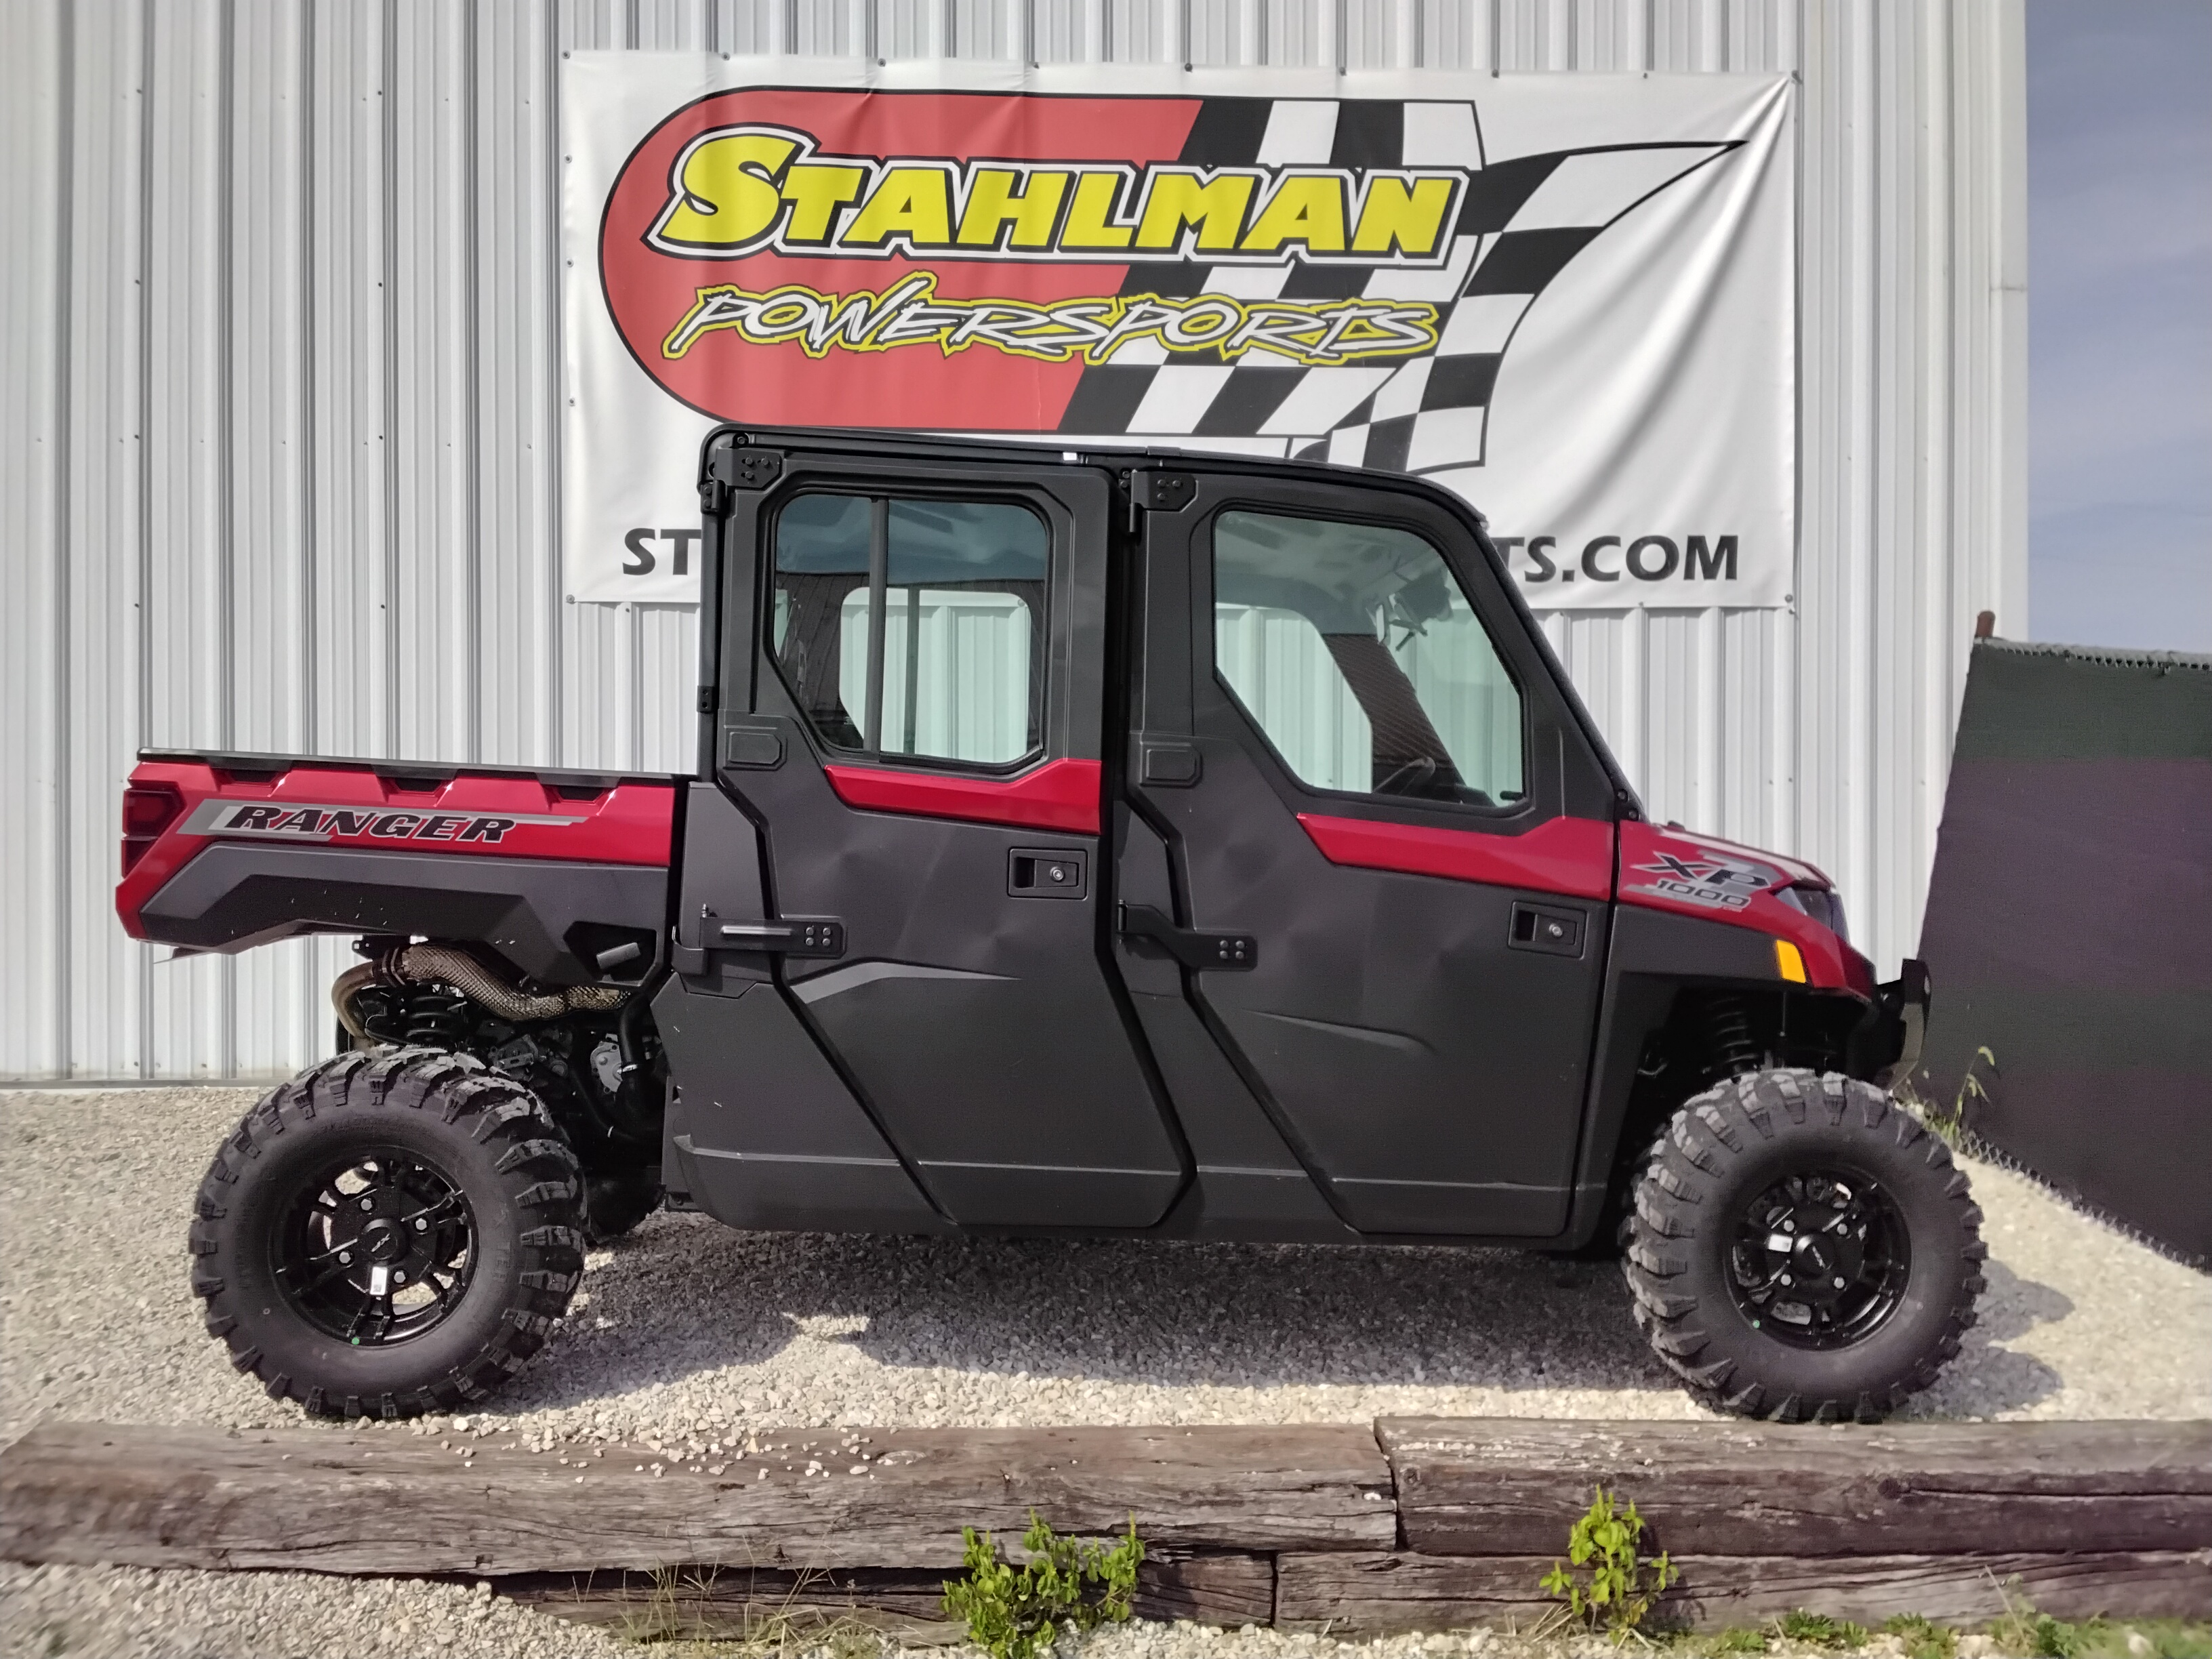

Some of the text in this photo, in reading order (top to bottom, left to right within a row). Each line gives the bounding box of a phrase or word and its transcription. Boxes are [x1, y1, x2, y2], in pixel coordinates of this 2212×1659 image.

[655, 129, 1461, 256] STAHLMAN
[665, 274, 1438, 361] POWERSPORTS
[222, 804, 517, 844] RANGER
[1635, 853, 1771, 887] XP
[1658, 880, 1750, 906] 1000
